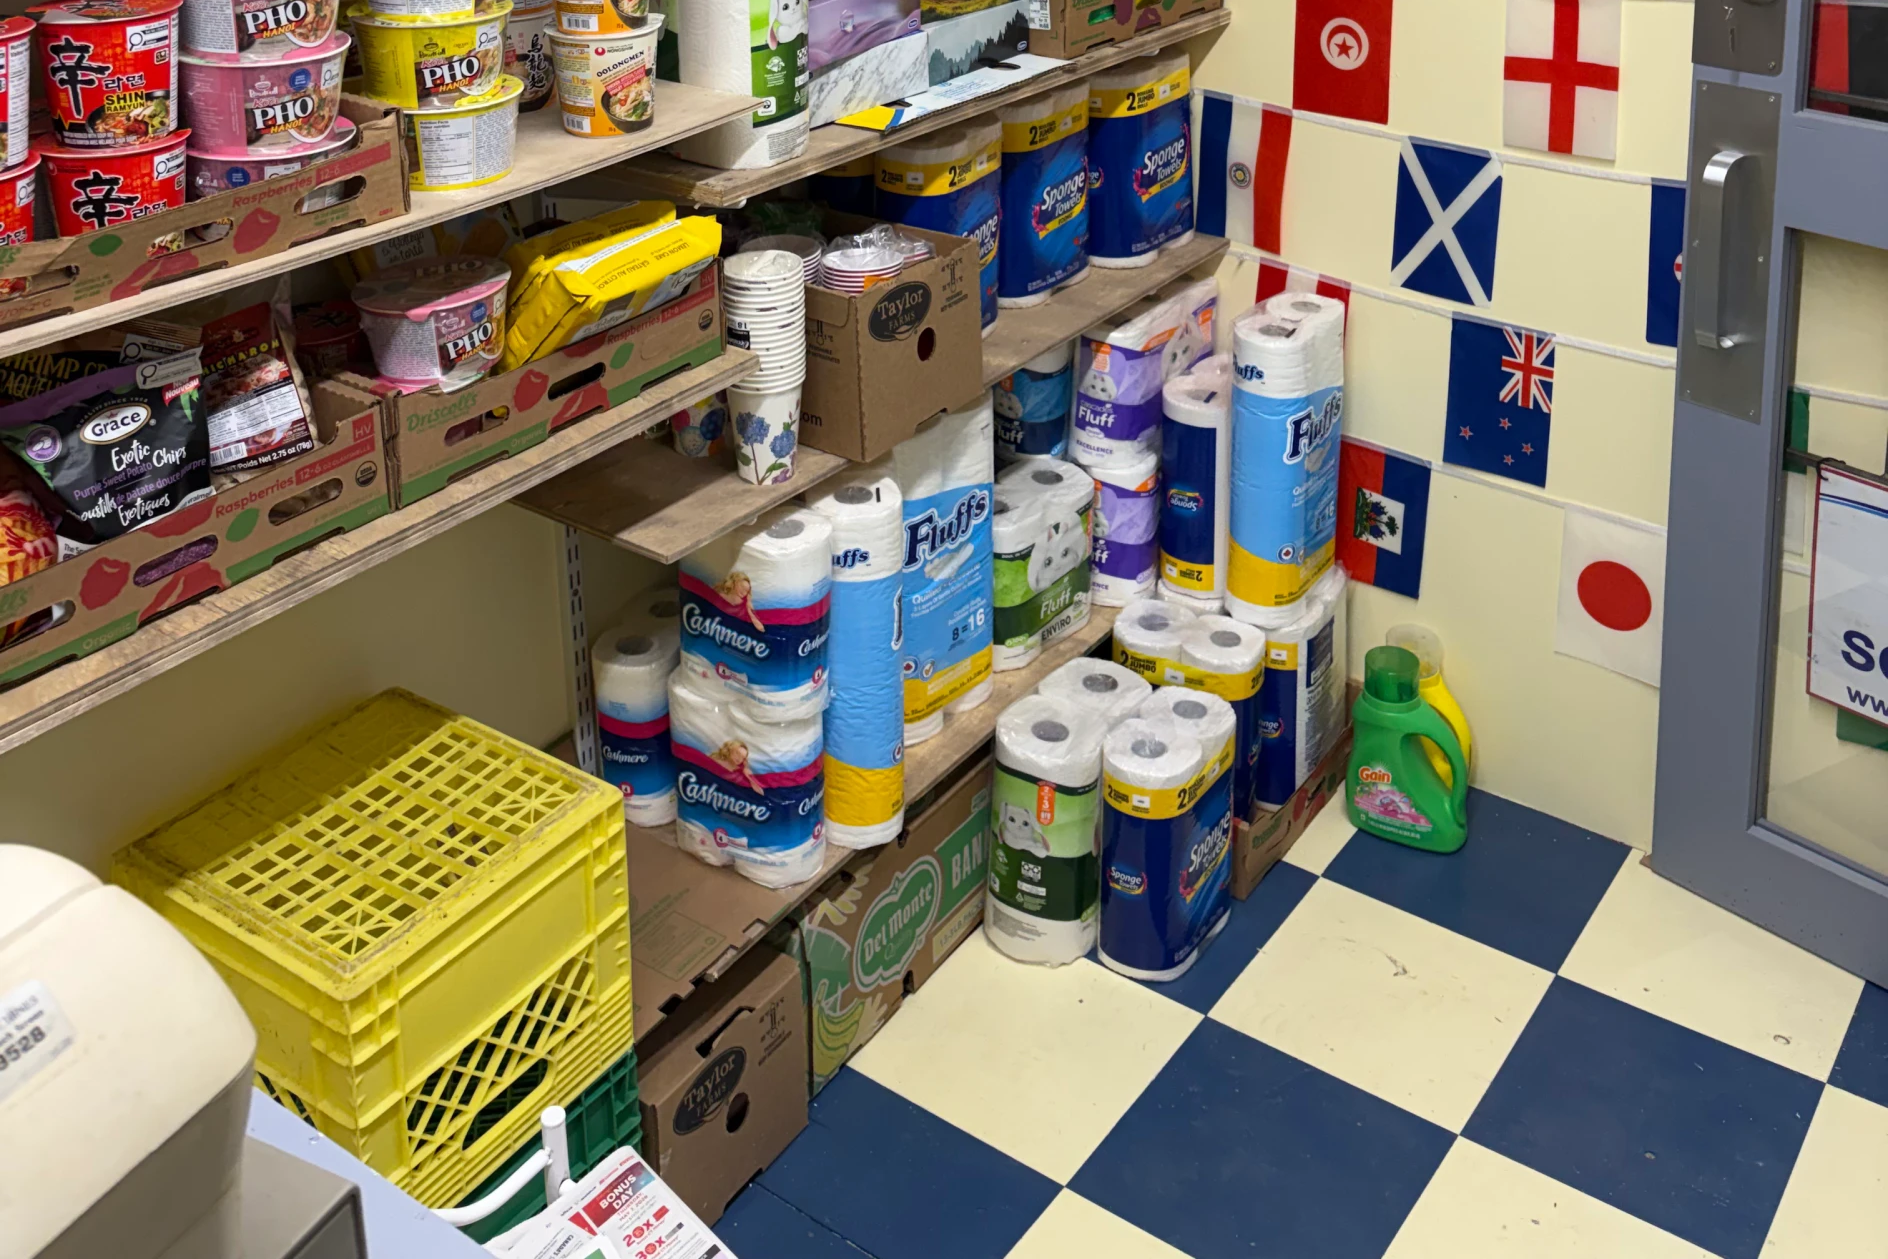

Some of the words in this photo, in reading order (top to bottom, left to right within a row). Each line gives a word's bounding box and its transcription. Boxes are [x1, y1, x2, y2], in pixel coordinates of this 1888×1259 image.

[244, 0, 306, 34] PHO
[263, 23, 296, 39] HANOI
[49, 36, 112, 118] 辛
[422, 55, 480, 89] PHO
[596, 50, 645, 77] OOLONGMEN
[104, 74, 145, 91] 라면
[439, 78, 469, 93] HANOI
[105, 91, 145, 106] SHIN
[106, 102, 145, 113] RAMYUN
[1126, 91, 1136, 111] 2
[253, 96, 314, 130] PHO
[270, 119, 302, 134] HANOI
[1029, 125, 1039, 146] 2
[1143, 137, 1185, 175] Sponge
[1156, 157, 1182, 182] Towels
[72, 171, 139, 229] 辛
[232, 174, 313, 208] Raspberries
[1041, 171, 1086, 211] Sponge
[1055, 191, 1083, 217] Towels
[655, 252, 669, 261] CAKE
[668, 242, 690, 256] LEMON
[878, 287, 924, 320] Taylor
[607, 314, 662, 346] Raspberries
[889, 311, 916, 331] FARMS
[446, 321, 493, 360] PHO
[165, 377, 199, 399] Nouveau
[91, 411, 142, 437] Grace
[406, 393, 478, 432] Driscoll's
[1078, 405, 1116, 428] Fluff
[355, 423, 373, 439] HV
[1288, 392, 1342, 462] Fluffs
[111, 439, 151, 472] Exotic
[152, 445, 187, 467] Chips
[258, 454, 272, 464] Net
[272, 449, 287, 461] 2.75
[287, 448, 296, 457] oz
[1076, 440, 1113, 455] EXCELLENCE
[73, 485, 102, 501] Purple
[103, 472, 127, 490] Sweet
[127, 461, 153, 481] Potato
[116, 494, 127, 505] de
[127, 483, 156, 506] patate
[157, 472, 180, 489] douce
[215, 475, 294, 519] Raspberries
[299, 464, 322, 480] 12-6
[118, 493, 170, 527] Exotiques
[1170, 497, 1198, 512] Sponge
[904, 493, 987, 567] Fluffs
[1040, 588, 1072, 620] Fluff
[682, 602, 770, 658] Cashmere
[967, 608, 985, 631] 16
[1041, 614, 1072, 640] ENVIRO
[603, 745, 649, 763] Cashmere
[1359, 765, 1391, 784] Gain
[678, 771, 770, 821] Cashmere
[1188, 810, 1231, 874] Sponge
[1110, 867, 1142, 886] Sponge
[864, 924, 887, 964] Del
[888, 882, 933, 939] Monte
[684, 1054, 736, 1112] Taylor
[599, 1174, 637, 1209] BONUS
[612, 1187, 634, 1210] DAY
